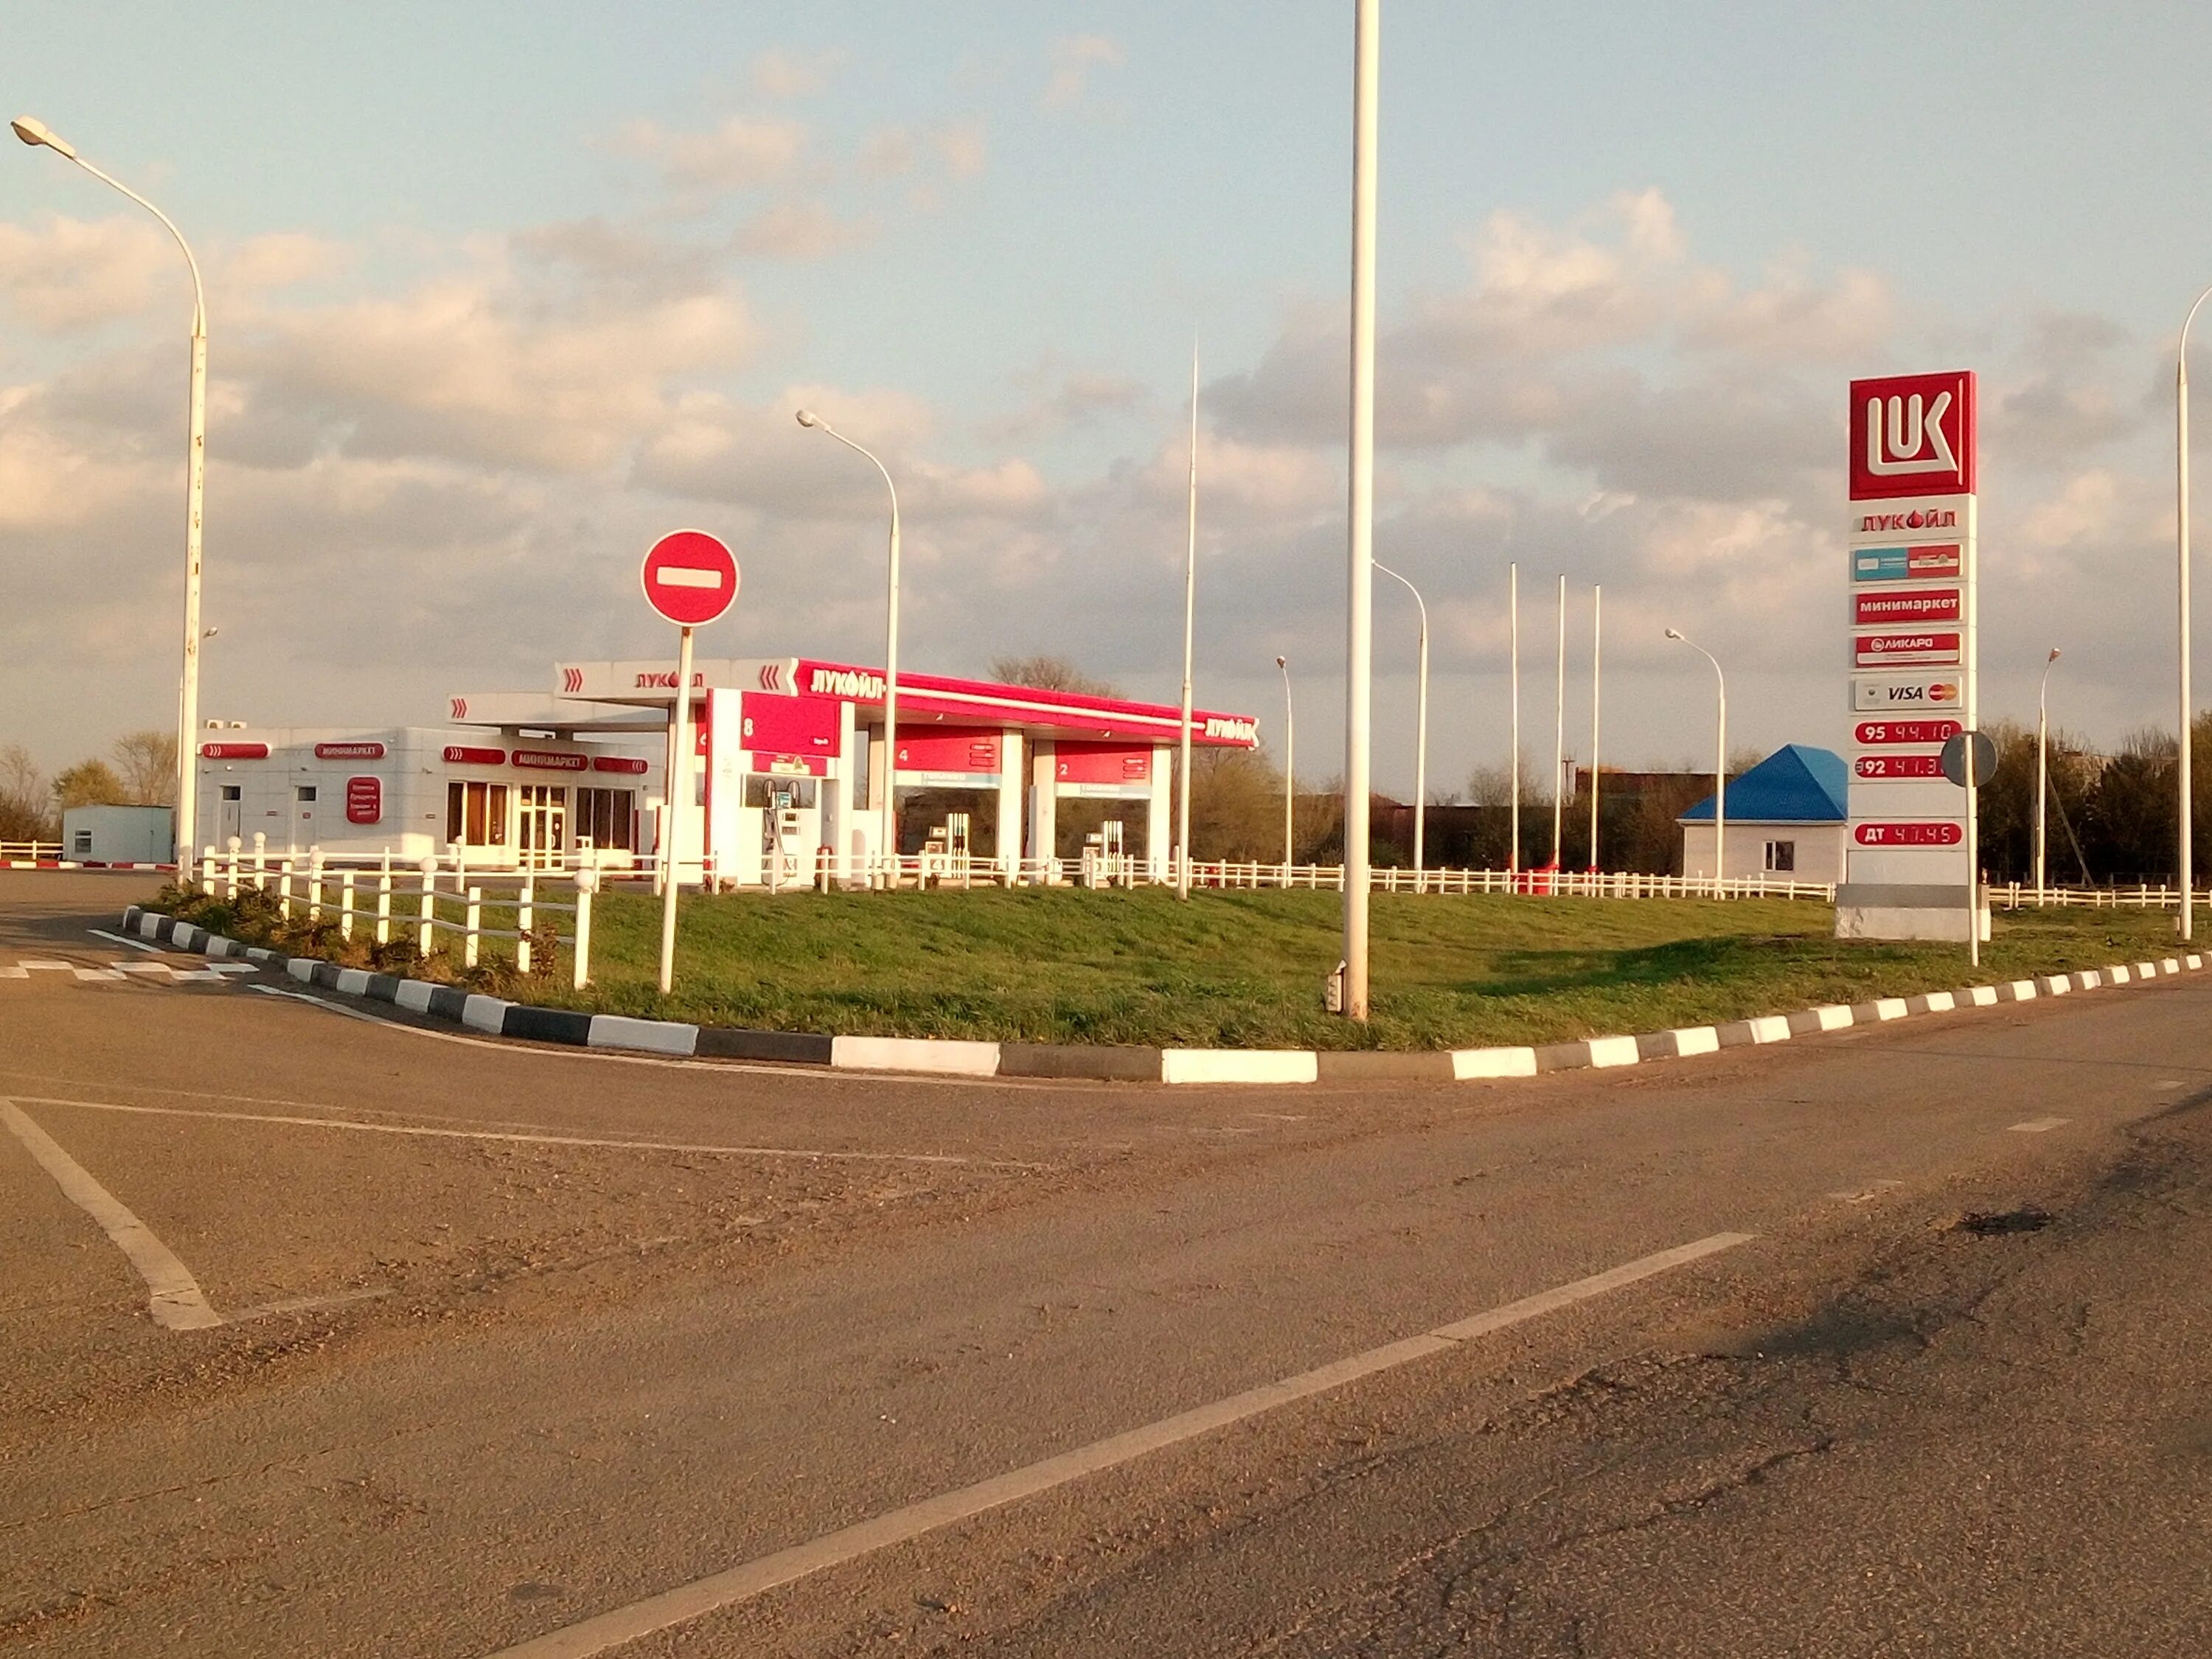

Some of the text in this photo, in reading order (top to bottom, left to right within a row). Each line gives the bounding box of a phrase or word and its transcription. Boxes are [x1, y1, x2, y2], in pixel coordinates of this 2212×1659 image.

[1861, 509, 1956, 532] ЛУКОЙЛ
[1860, 598, 1958, 613] минимаркет
[810, 668, 883, 700] ЛУКОЙЛ
[1888, 686, 1924, 700] VISA
[743, 717, 754, 737] 8
[1865, 724, 1952, 740] 95 44.10
[898, 749, 908, 762] 4
[1060, 763, 1068, 776] 2
[1865, 760, 1886, 774] 92
[1864, 827, 1885, 843] ДТ
